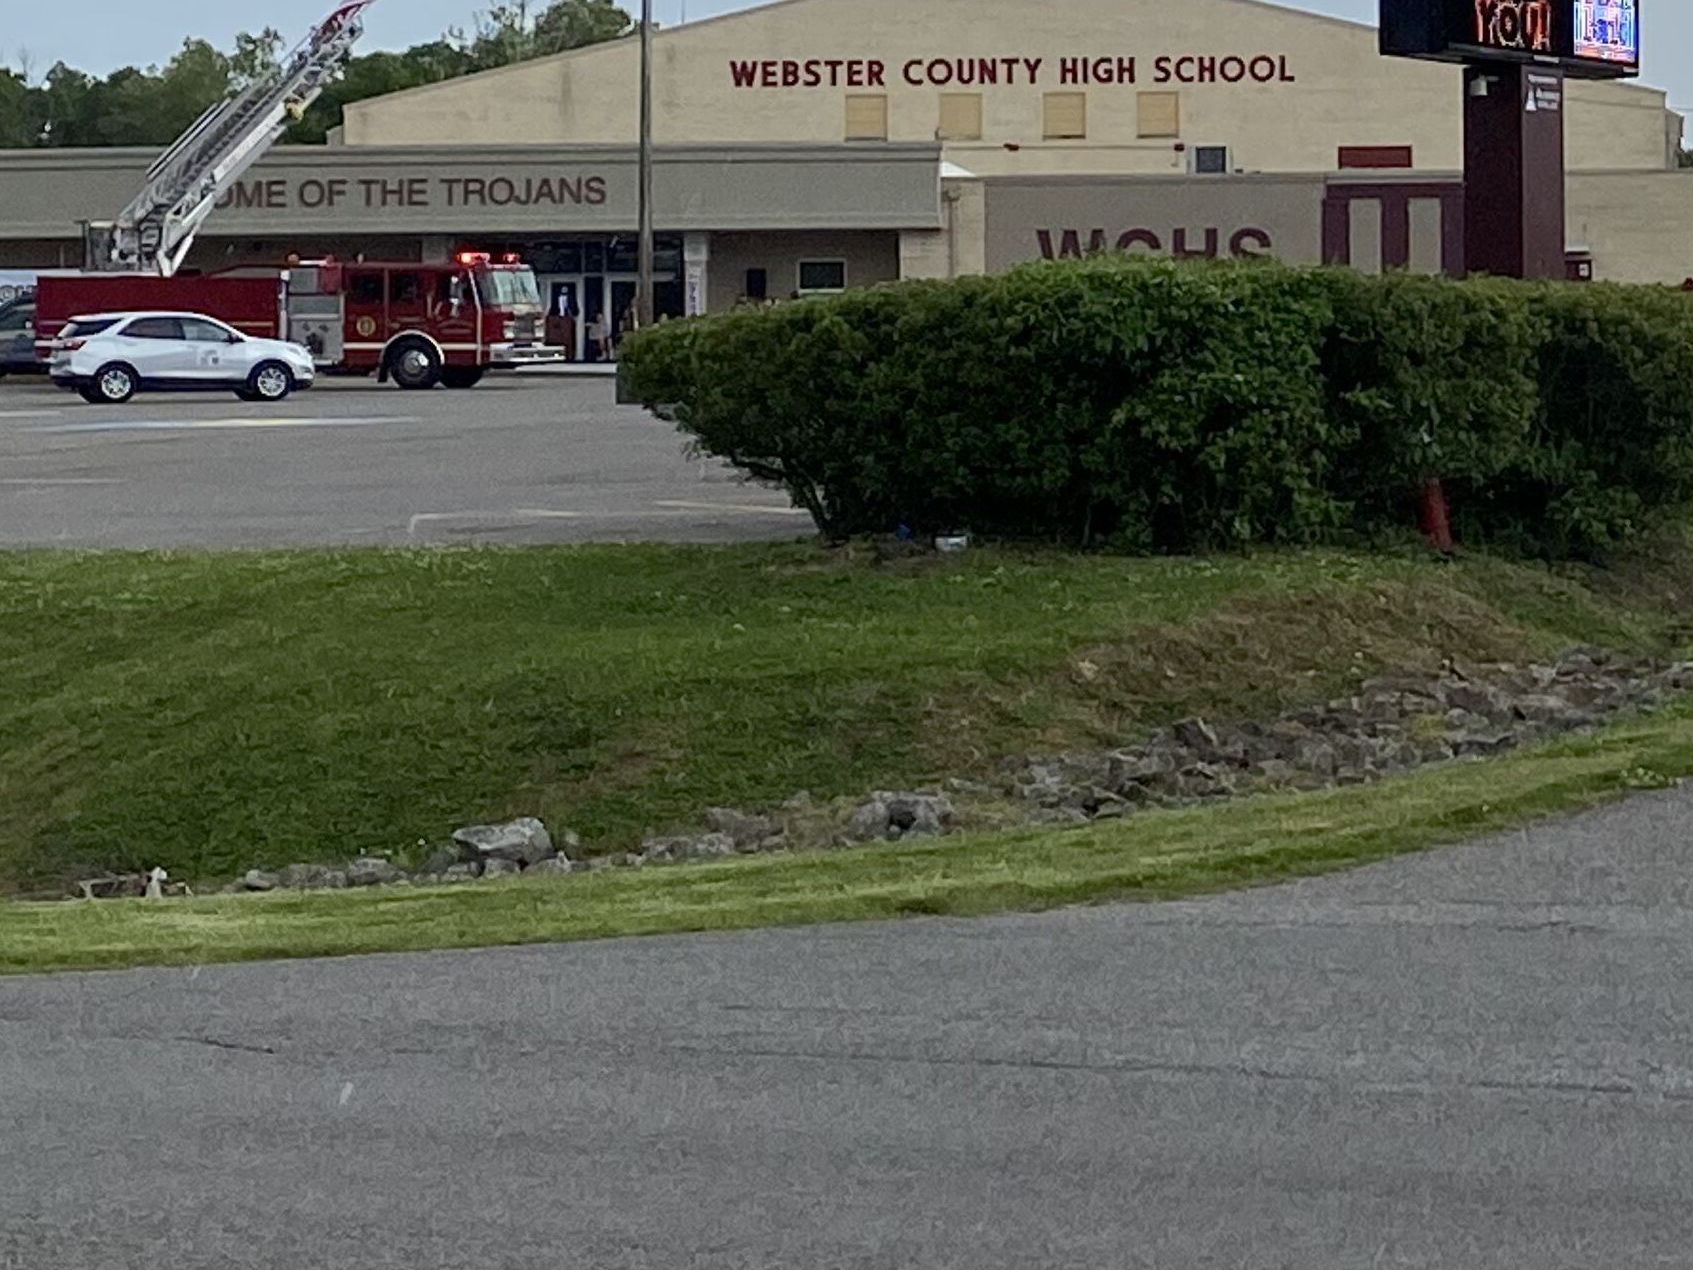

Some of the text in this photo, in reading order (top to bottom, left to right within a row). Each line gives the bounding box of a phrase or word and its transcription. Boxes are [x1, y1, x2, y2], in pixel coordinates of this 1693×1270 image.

[729, 55, 1295, 88] WEBSTER COUNTY HIGH SCHOOL
[213, 175, 608, 209] OME OF THE TROJANS
